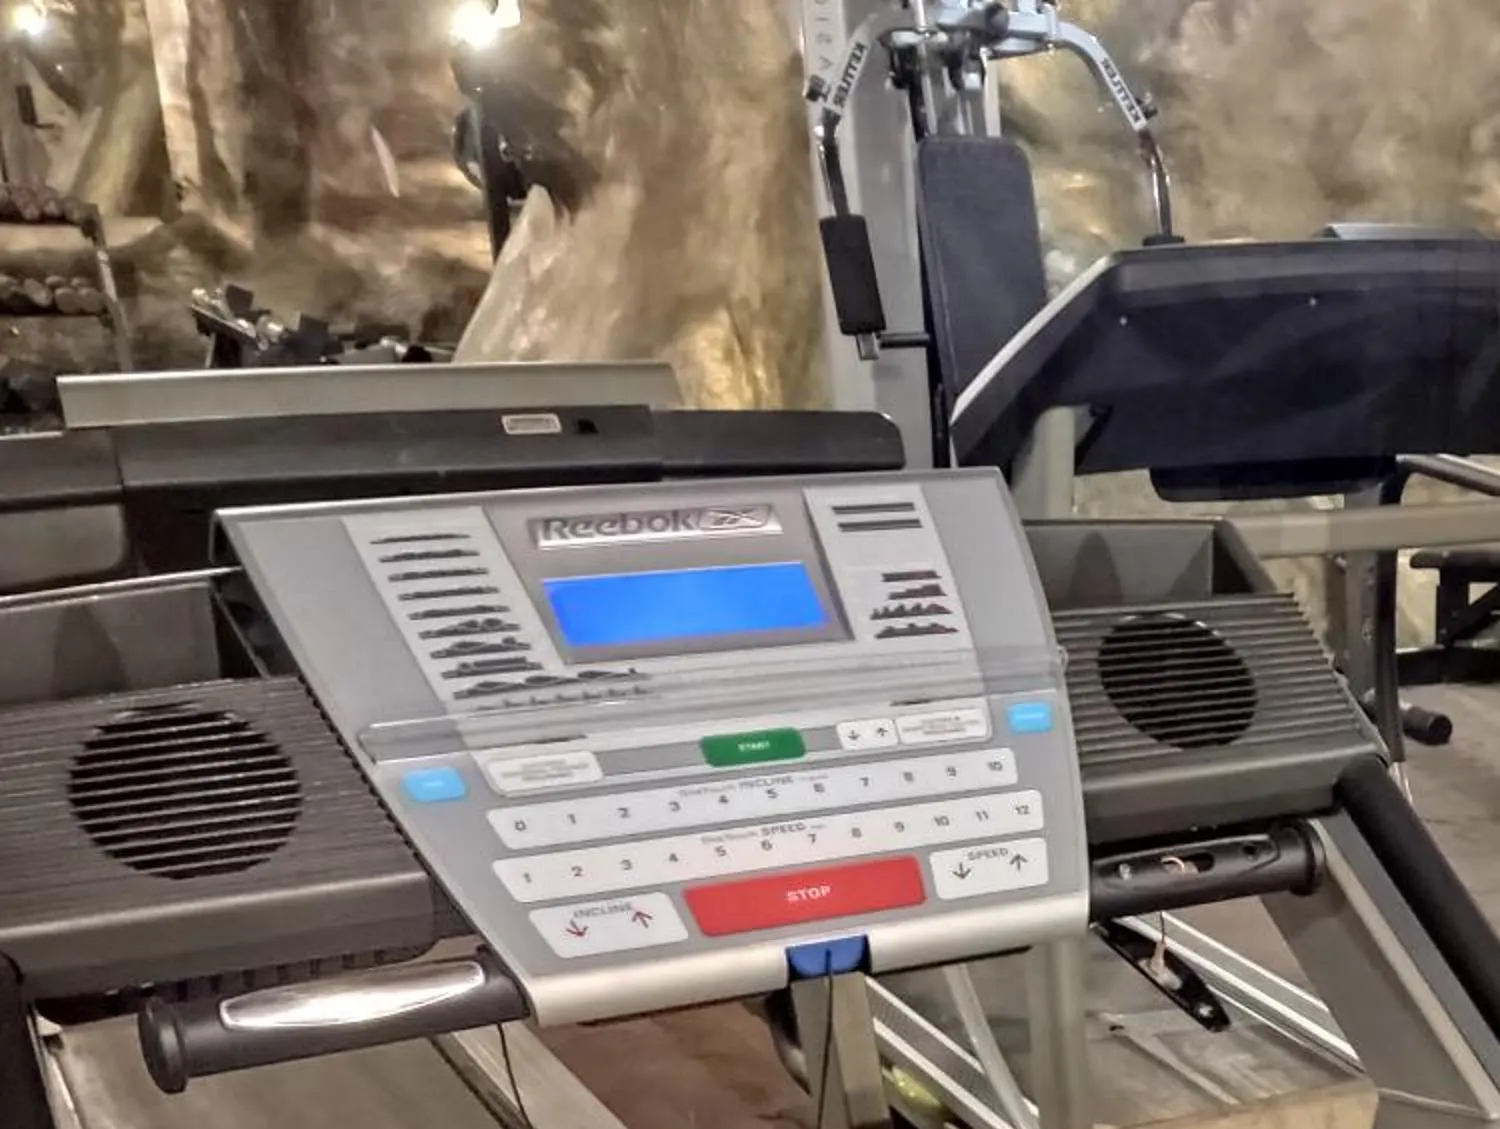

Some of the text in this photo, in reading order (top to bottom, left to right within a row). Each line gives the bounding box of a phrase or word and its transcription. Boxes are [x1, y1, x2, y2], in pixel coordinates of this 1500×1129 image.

[543, 509, 698, 541] Reebok
[514, 820, 527, 832] 0
[617, 807, 631, 819] 2
[669, 801, 681, 813] 3
[766, 788, 778, 799] 5
[859, 776, 871, 788] 7
[986, 760, 1003, 772] 10
[572, 865, 583, 878] 2
[621, 858, 633, 871] 3
[669, 853, 680, 863] 4
[715, 846, 727, 857] 5
[761, 840, 773, 852] 6
[808, 833, 817, 844] 7
[851, 828, 862, 839] 8
[895, 821, 905, 833] 9
[935, 815, 950, 827] 10
[975, 810, 989, 822] 11
[1015, 805, 1030, 816] 12
[967, 847, 1009, 861] SPEED
[786, 885, 832, 905] STOP
[573, 902, 633, 918] INCLINE
